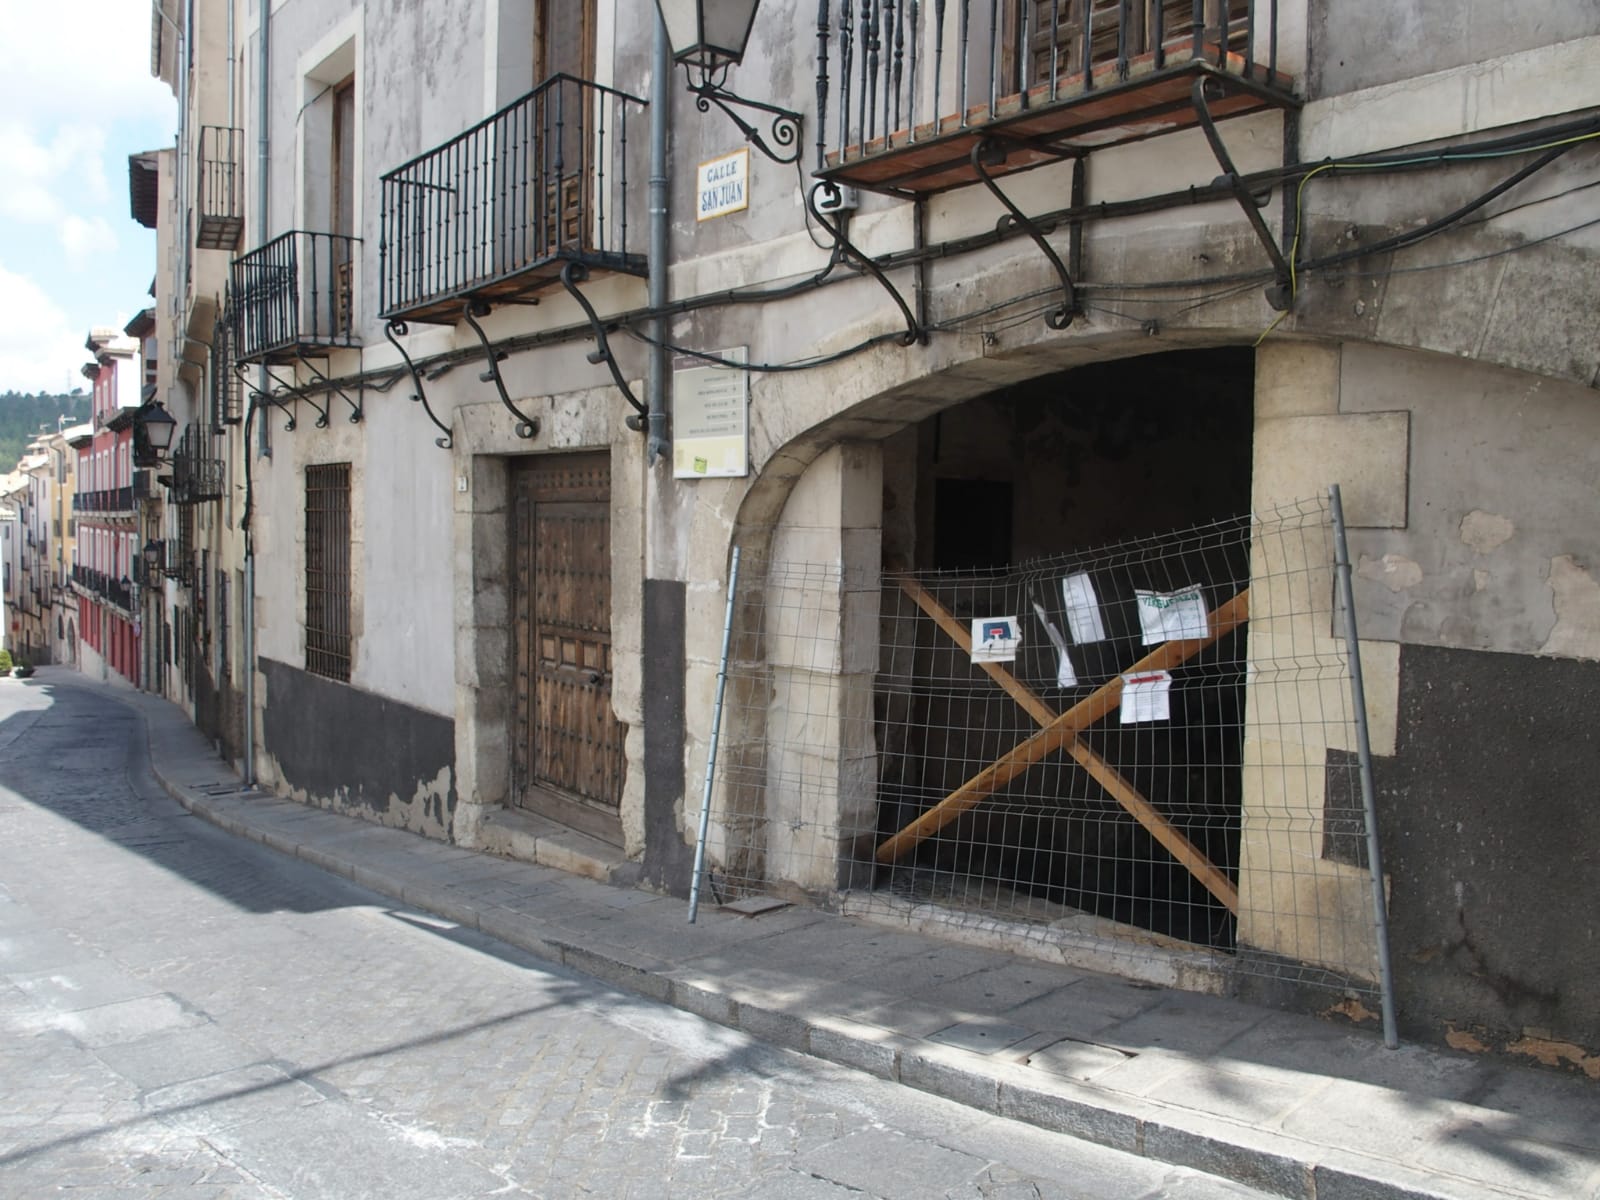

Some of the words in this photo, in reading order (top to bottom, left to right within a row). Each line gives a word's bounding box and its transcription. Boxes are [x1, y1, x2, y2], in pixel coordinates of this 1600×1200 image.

[707, 160, 737, 183] CALLE
[701, 187, 718, 211] SAN
[719, 180, 743, 207] JUAN
